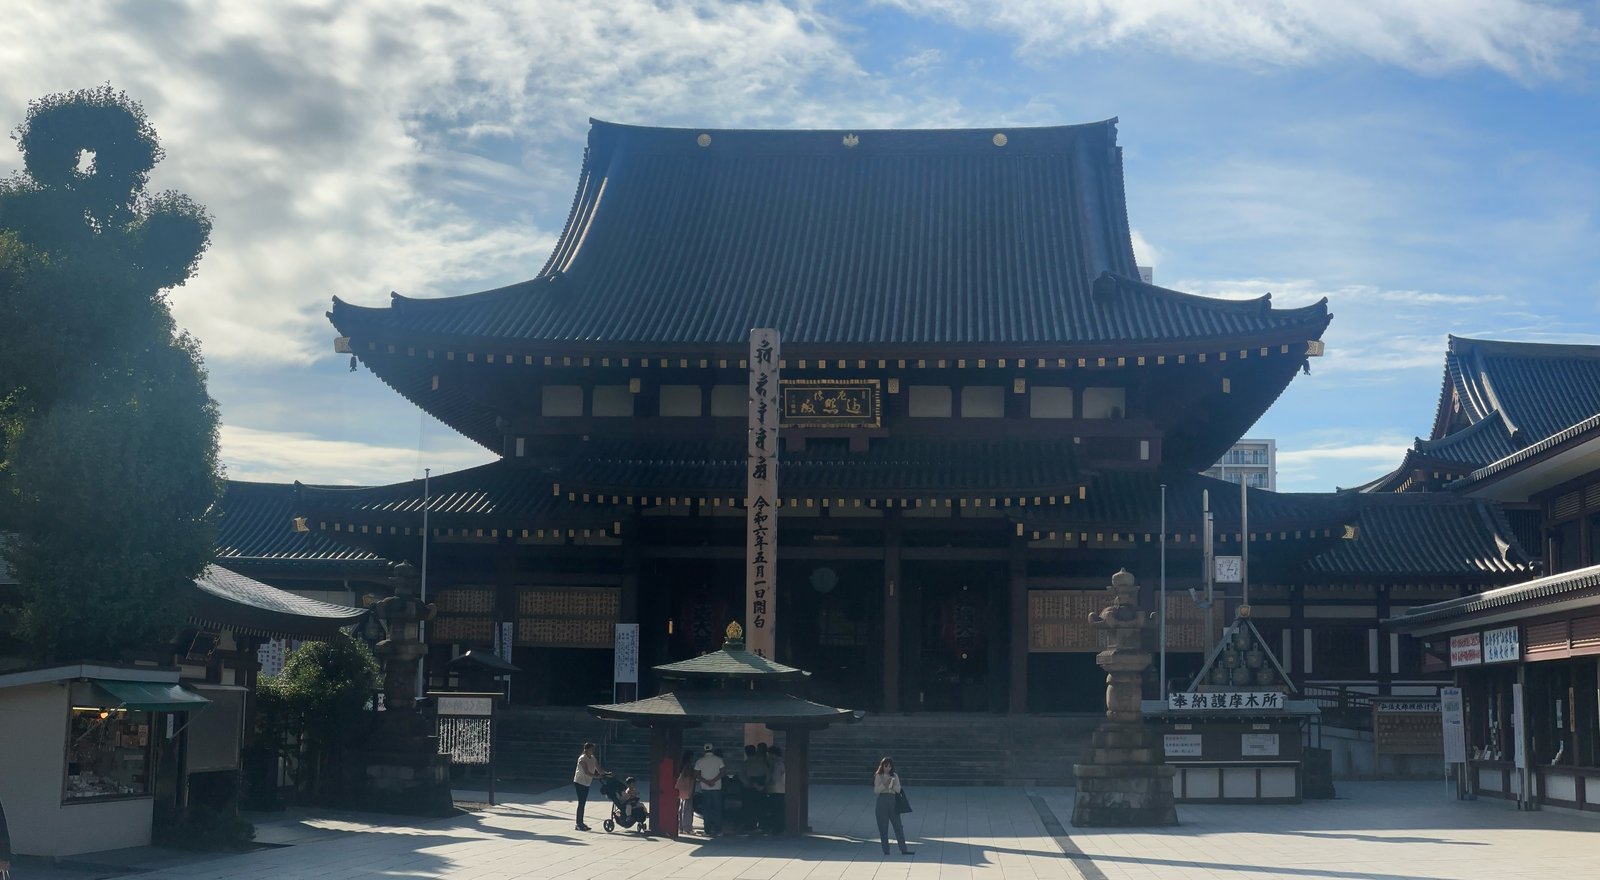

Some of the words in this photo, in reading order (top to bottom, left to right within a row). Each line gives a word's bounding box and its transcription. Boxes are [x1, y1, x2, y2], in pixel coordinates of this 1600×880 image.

[753, 495, 768, 629] 令和六年五月一日開白
[1173, 693, 1278, 708] 奉納護摩木所
